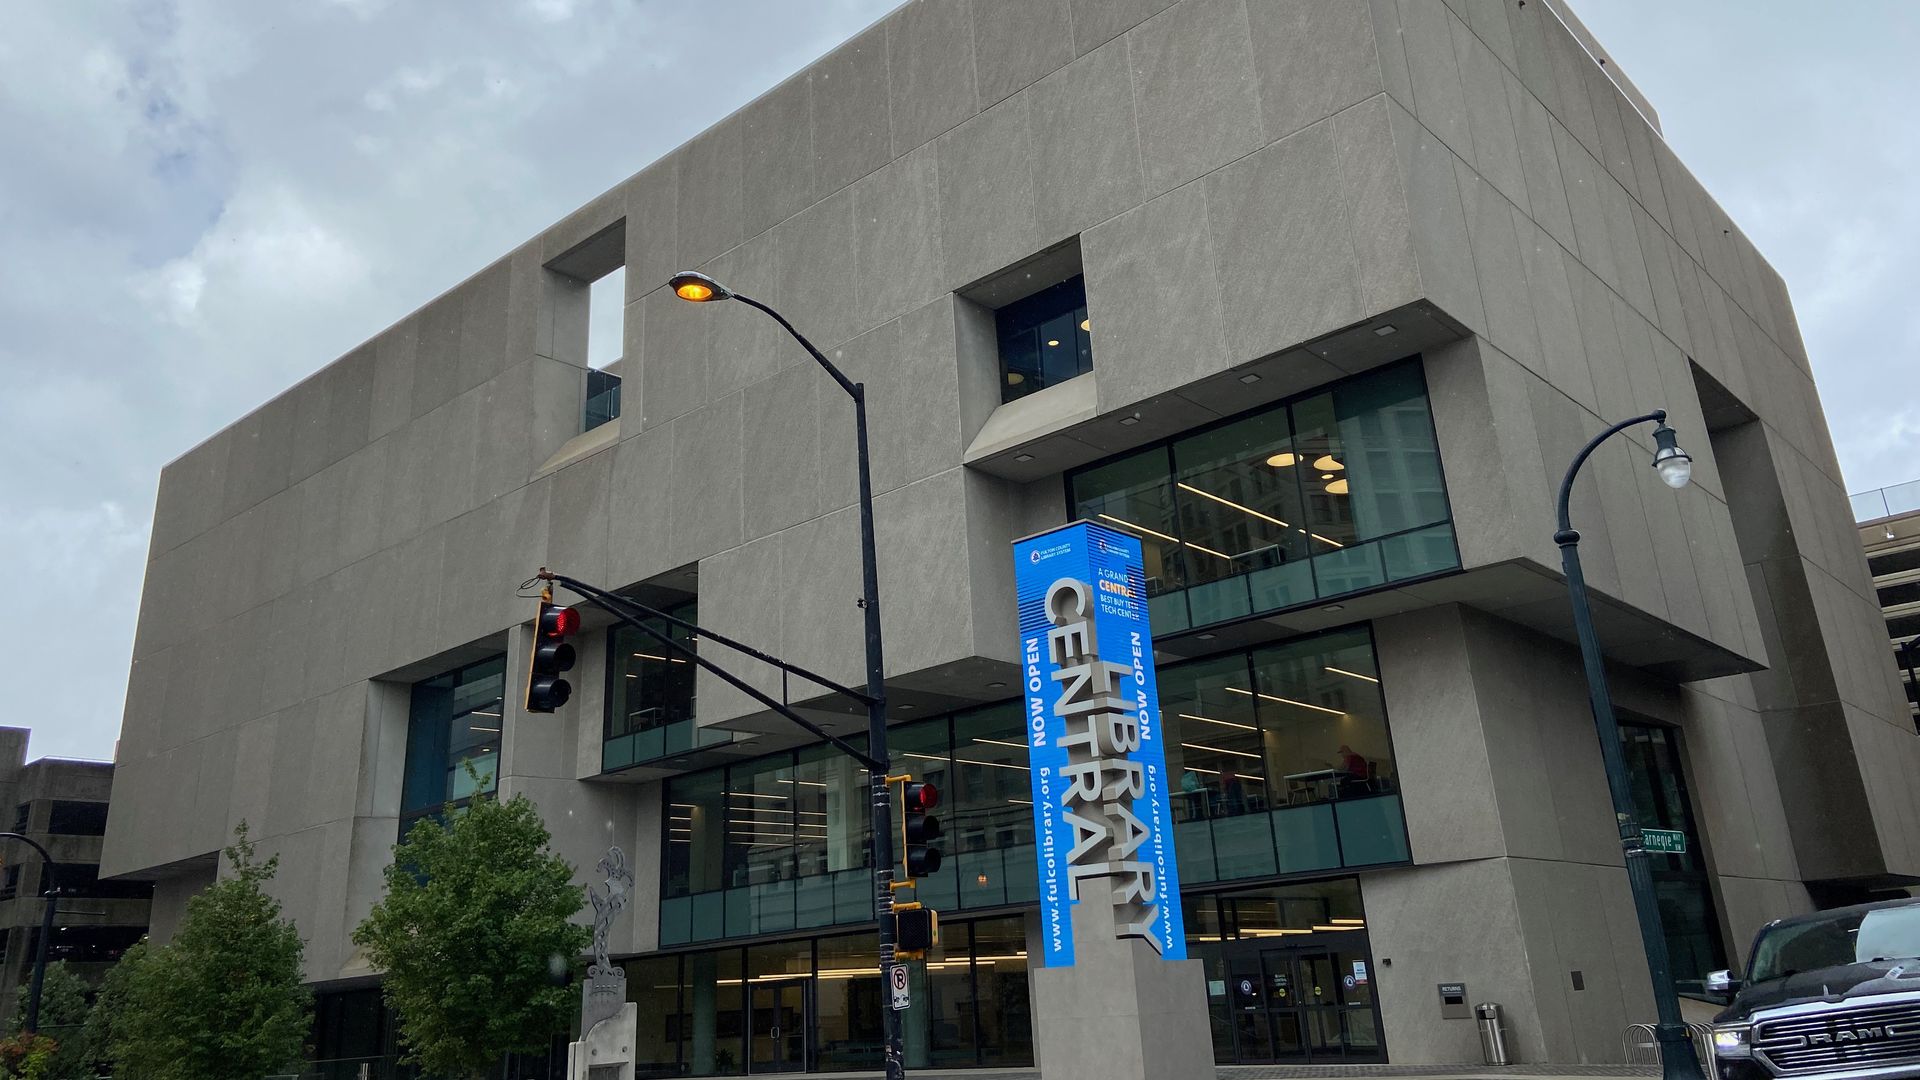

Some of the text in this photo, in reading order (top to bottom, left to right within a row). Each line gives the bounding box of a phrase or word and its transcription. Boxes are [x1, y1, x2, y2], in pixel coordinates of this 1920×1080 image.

[1098, 567, 1128, 583] A GRAND
[1100, 594, 1113, 605] BEST
[1113, 597, 1125, 607] BUY
[1101, 604, 1117, 615] TECH
[1026, 637, 1046, 748] NOW OPEN
[1045, 577, 1110, 901] CENTRAL
[1131, 631, 1151, 741] NOW OPEN
[1040, 767, 1062, 952] www.fulcolibrary.org
[1100, 660, 1164, 956] LIBRARY
[1148, 765, 1173, 949] www.fulcolibrary.org
[1641, 831, 1672, 851] arnegie
[1809, 1027, 1883, 1045] RAM
